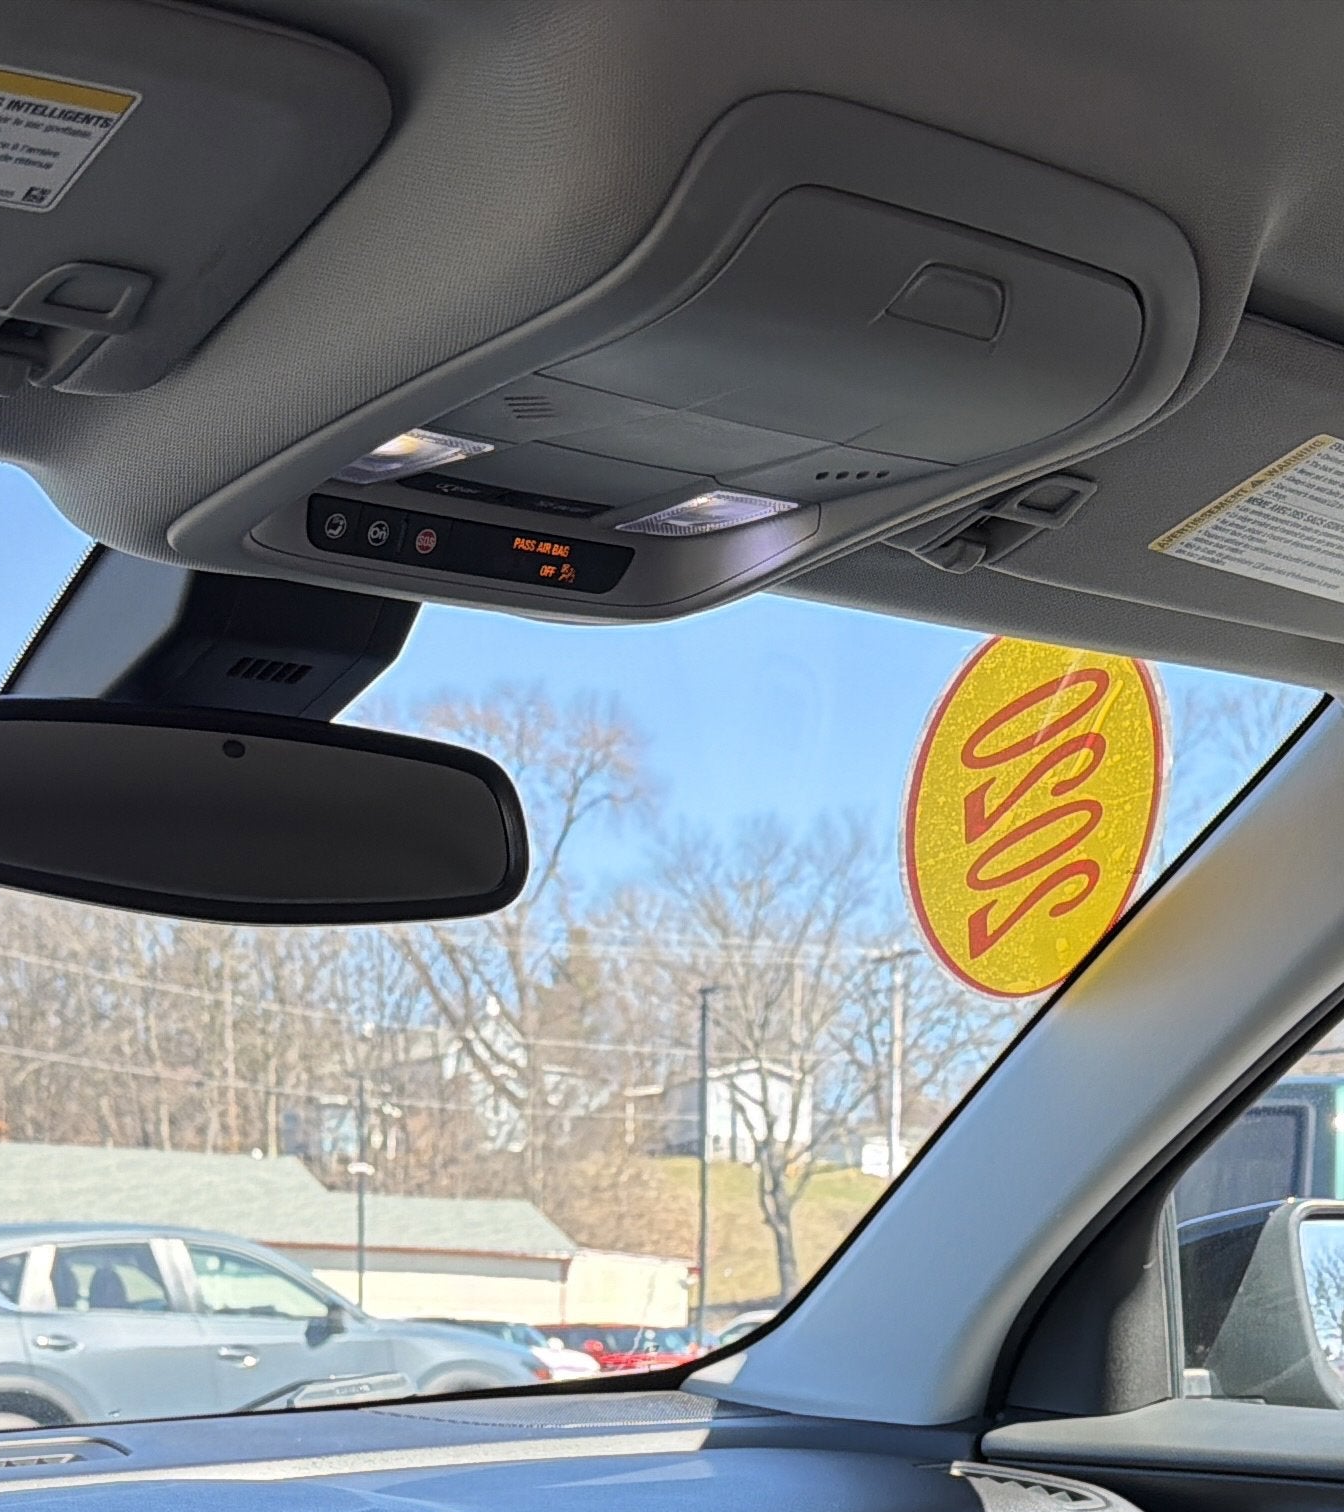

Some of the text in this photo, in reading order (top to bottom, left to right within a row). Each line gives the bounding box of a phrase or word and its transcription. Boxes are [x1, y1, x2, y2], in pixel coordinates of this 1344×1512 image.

[5, 97, 117, 127] INTELLIGENTS
[513, 537, 570, 558] PASS AIR BAG
[539, 564, 556, 577] OFF
